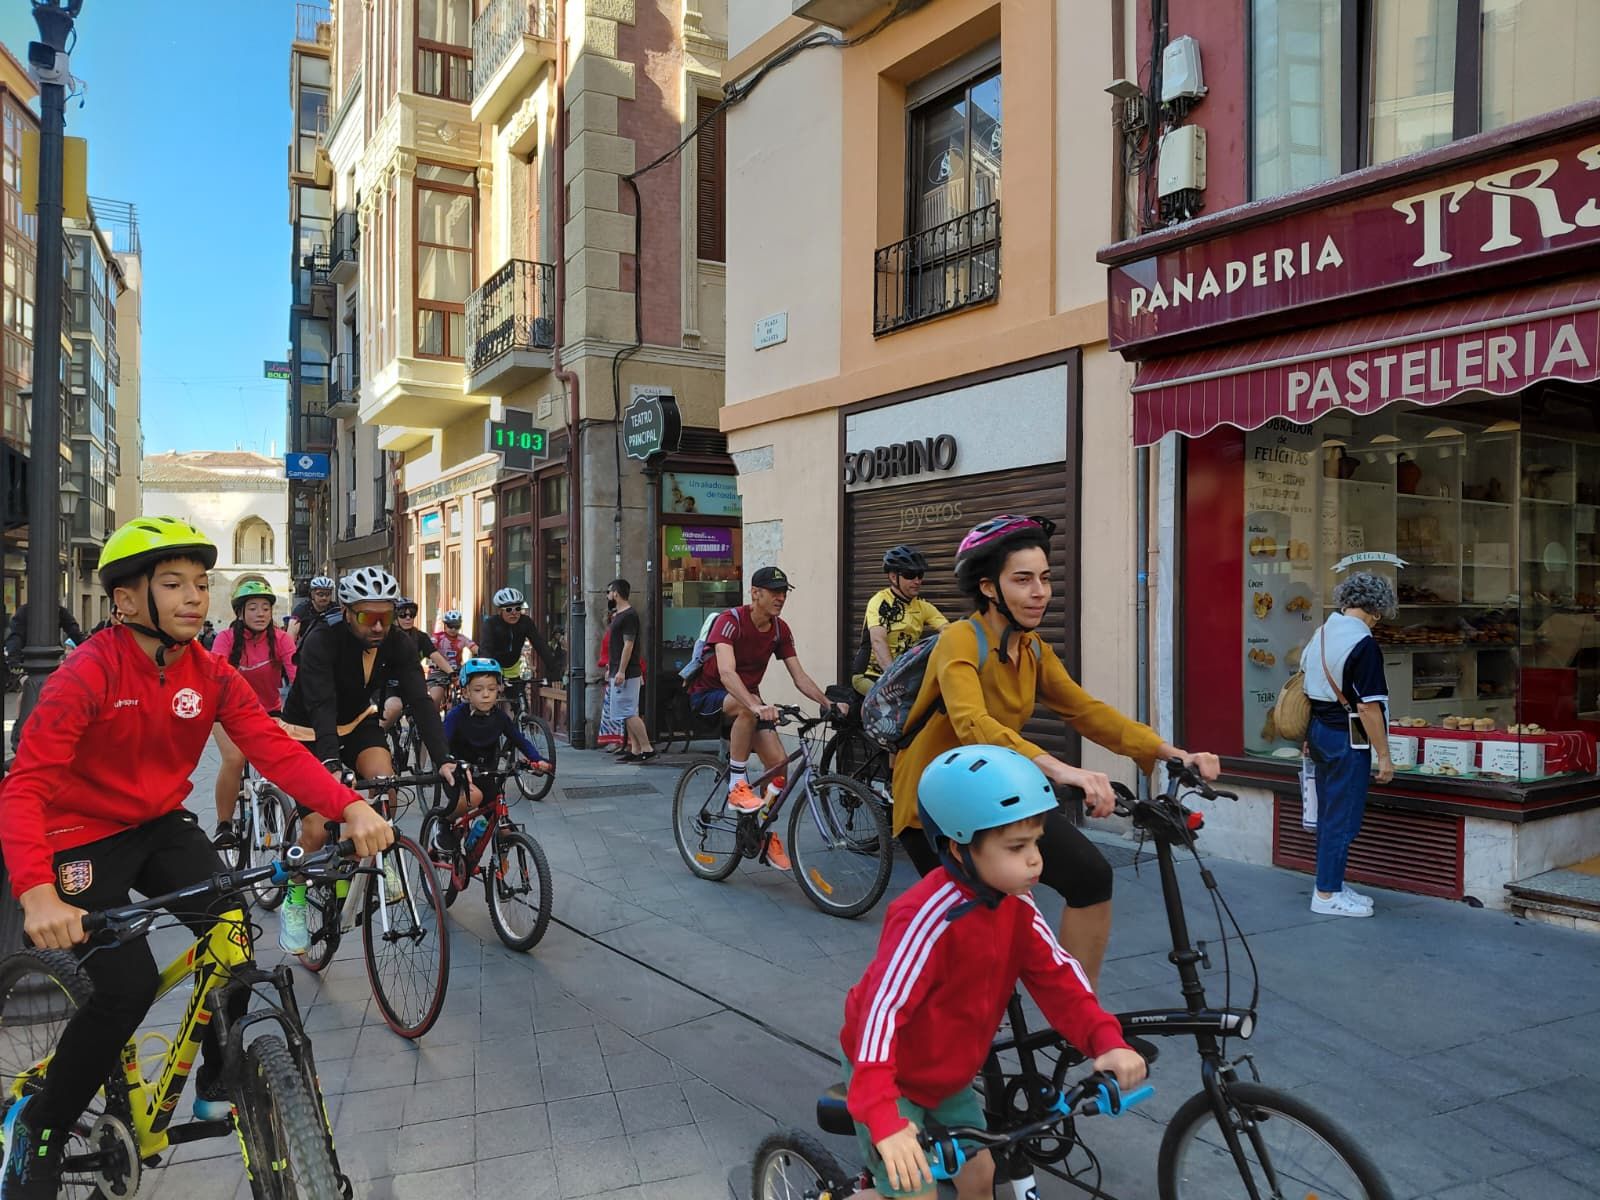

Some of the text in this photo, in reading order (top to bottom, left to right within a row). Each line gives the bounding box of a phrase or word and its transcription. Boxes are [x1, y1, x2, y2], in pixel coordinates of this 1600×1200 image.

[1131, 234, 1344, 318] PANADERIA
[267, 371, 291, 379] BOLS
[1287, 323, 1590, 413] PASTELERIA
[631, 409, 653, 428] TEATRO
[495, 428, 543, 451] 11:03
[628, 428, 657, 447] PRINCIPAL
[844, 433, 958, 486] SOBRINO
[898, 502, 963, 532] joyeros
